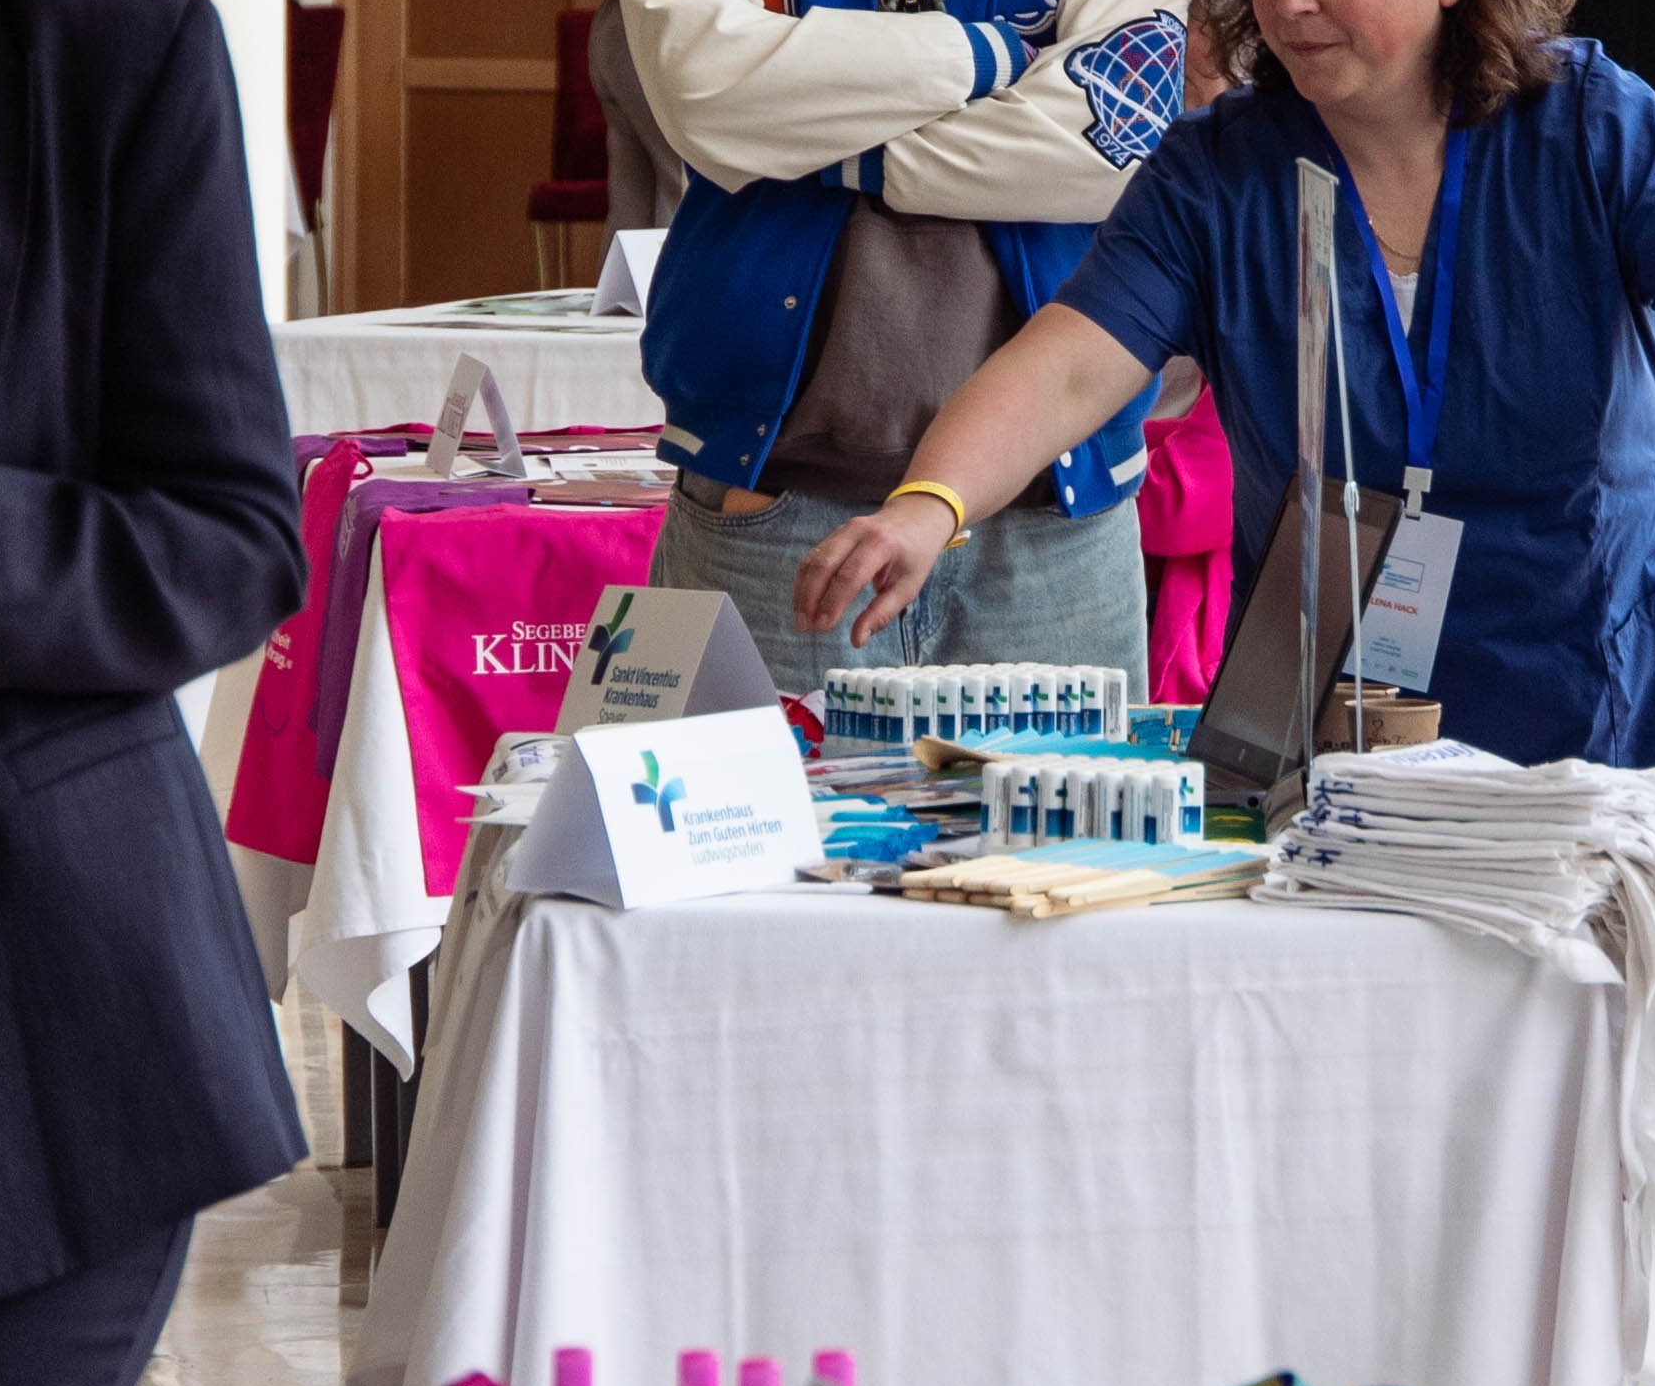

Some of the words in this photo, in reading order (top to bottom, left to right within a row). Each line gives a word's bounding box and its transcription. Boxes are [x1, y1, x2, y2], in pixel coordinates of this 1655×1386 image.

[1087, 122, 1130, 165] 1974
[511, 620, 589, 641] SEGEBE
[471, 634, 583, 675] KLIN
[610, 665, 636, 685] Sankt
[635, 667, 681, 688] Vincentius
[603, 686, 661, 709] Krankenhaus
[682, 804, 754, 826] Krankenhaus
[688, 830, 712, 846] Zum
[713, 824, 746, 842] Guten
[746, 819, 783, 836] Hirten
